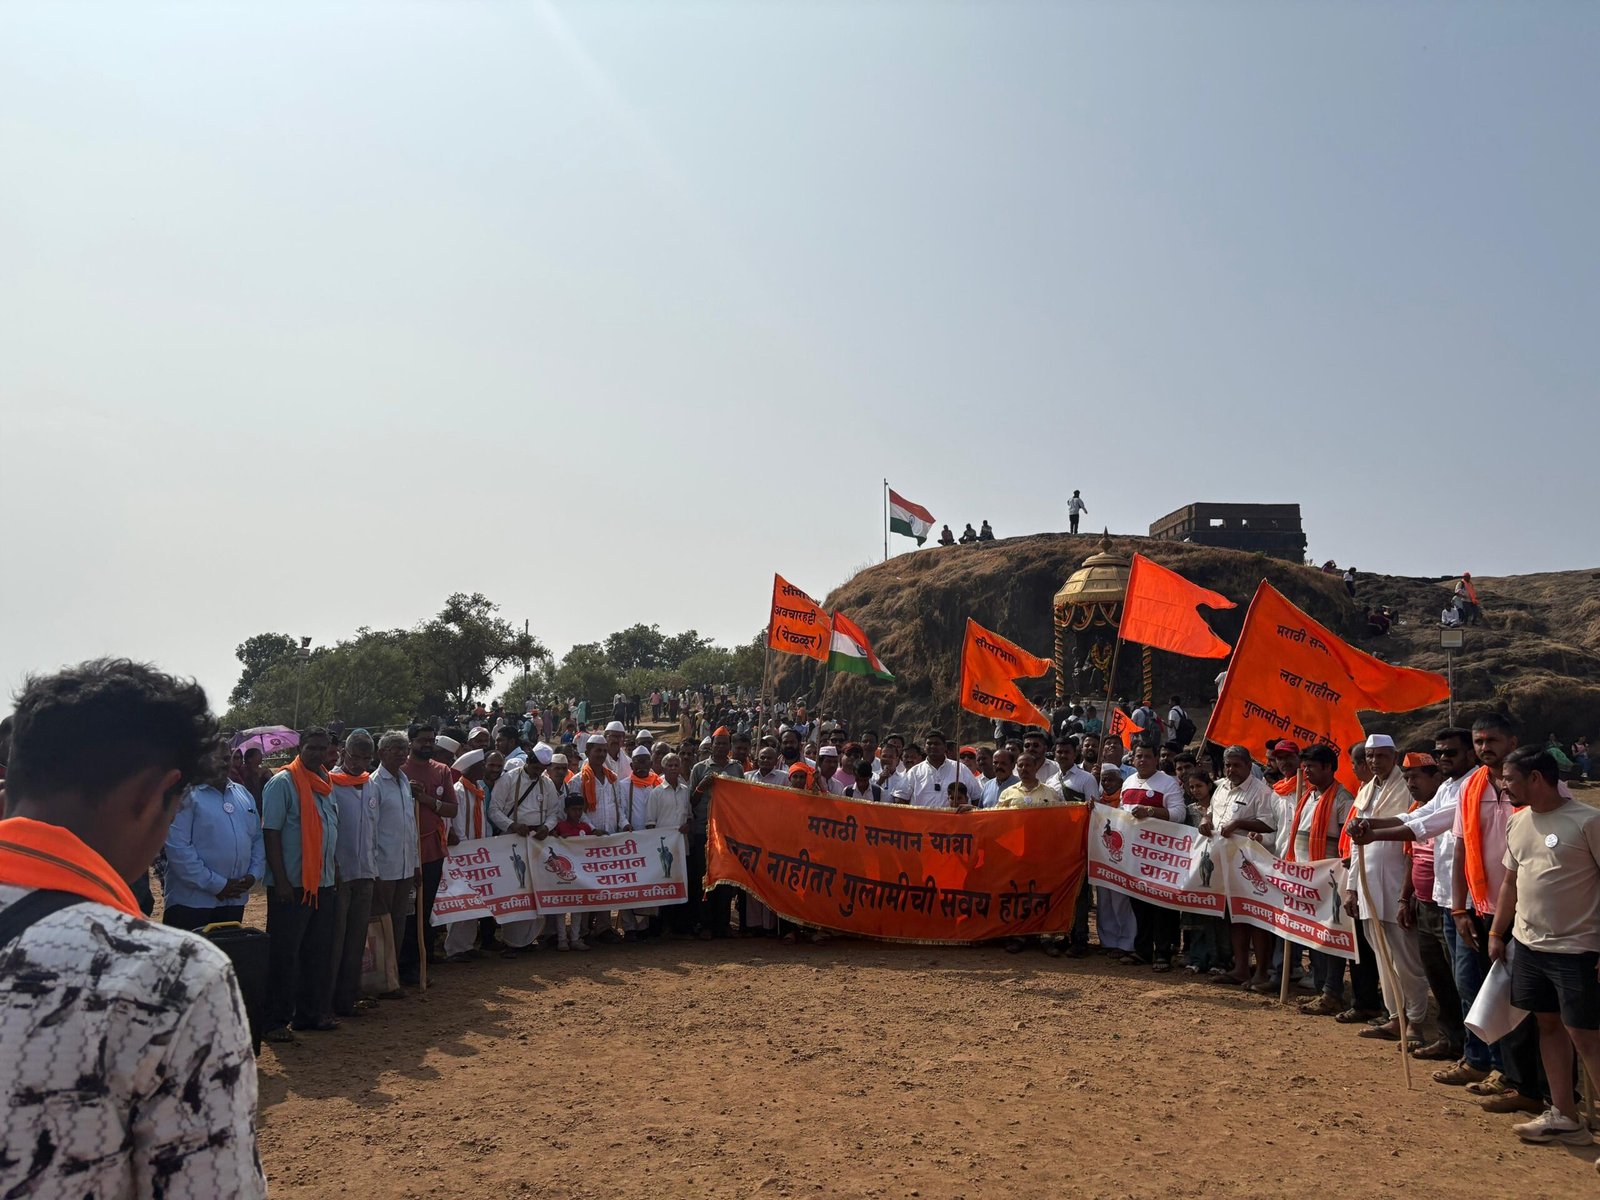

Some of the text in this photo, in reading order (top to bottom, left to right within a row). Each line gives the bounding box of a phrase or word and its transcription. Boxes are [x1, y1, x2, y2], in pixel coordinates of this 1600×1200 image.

[1277, 625, 1331, 656] मराठी सन्
[972, 684, 1017, 713] बेळगांव
[1280, 669, 1341, 705] लढा नाहीतर
[1242, 700, 1291, 732] गुलामीची
[1293, 724, 1317, 743] सवय
[585, 839, 638, 858] मराठी
[808, 815, 974, 857] मराठी सन्मान यात्रा
[1140, 828, 1193, 852] मराठी
[581, 856, 647, 873] सन्मान
[1131, 843, 1193, 870] सन्मान
[448, 865, 501, 882] समान
[596, 872, 638, 885] यात्रा
[1140, 862, 1180, 885] यात्रा
[1272, 857, 1315, 882] मराठी
[542, 885, 677, 905] महाराष्ट्र एकीकरण समिती
[767, 849, 837, 897] नाहीतर
[839, 872, 937, 917] गुलामीची
[940, 888, 992, 919] सवय
[998, 879, 1053, 923] होईल
[1097, 867, 1216, 906] महाराष्ट्र एकीकरण समिती
[500, 896, 531, 909] समिती
[1283, 894, 1317, 917] यात्रा
[1242, 902, 1350, 946] महाराष्ट्र एकीकरण समिती
